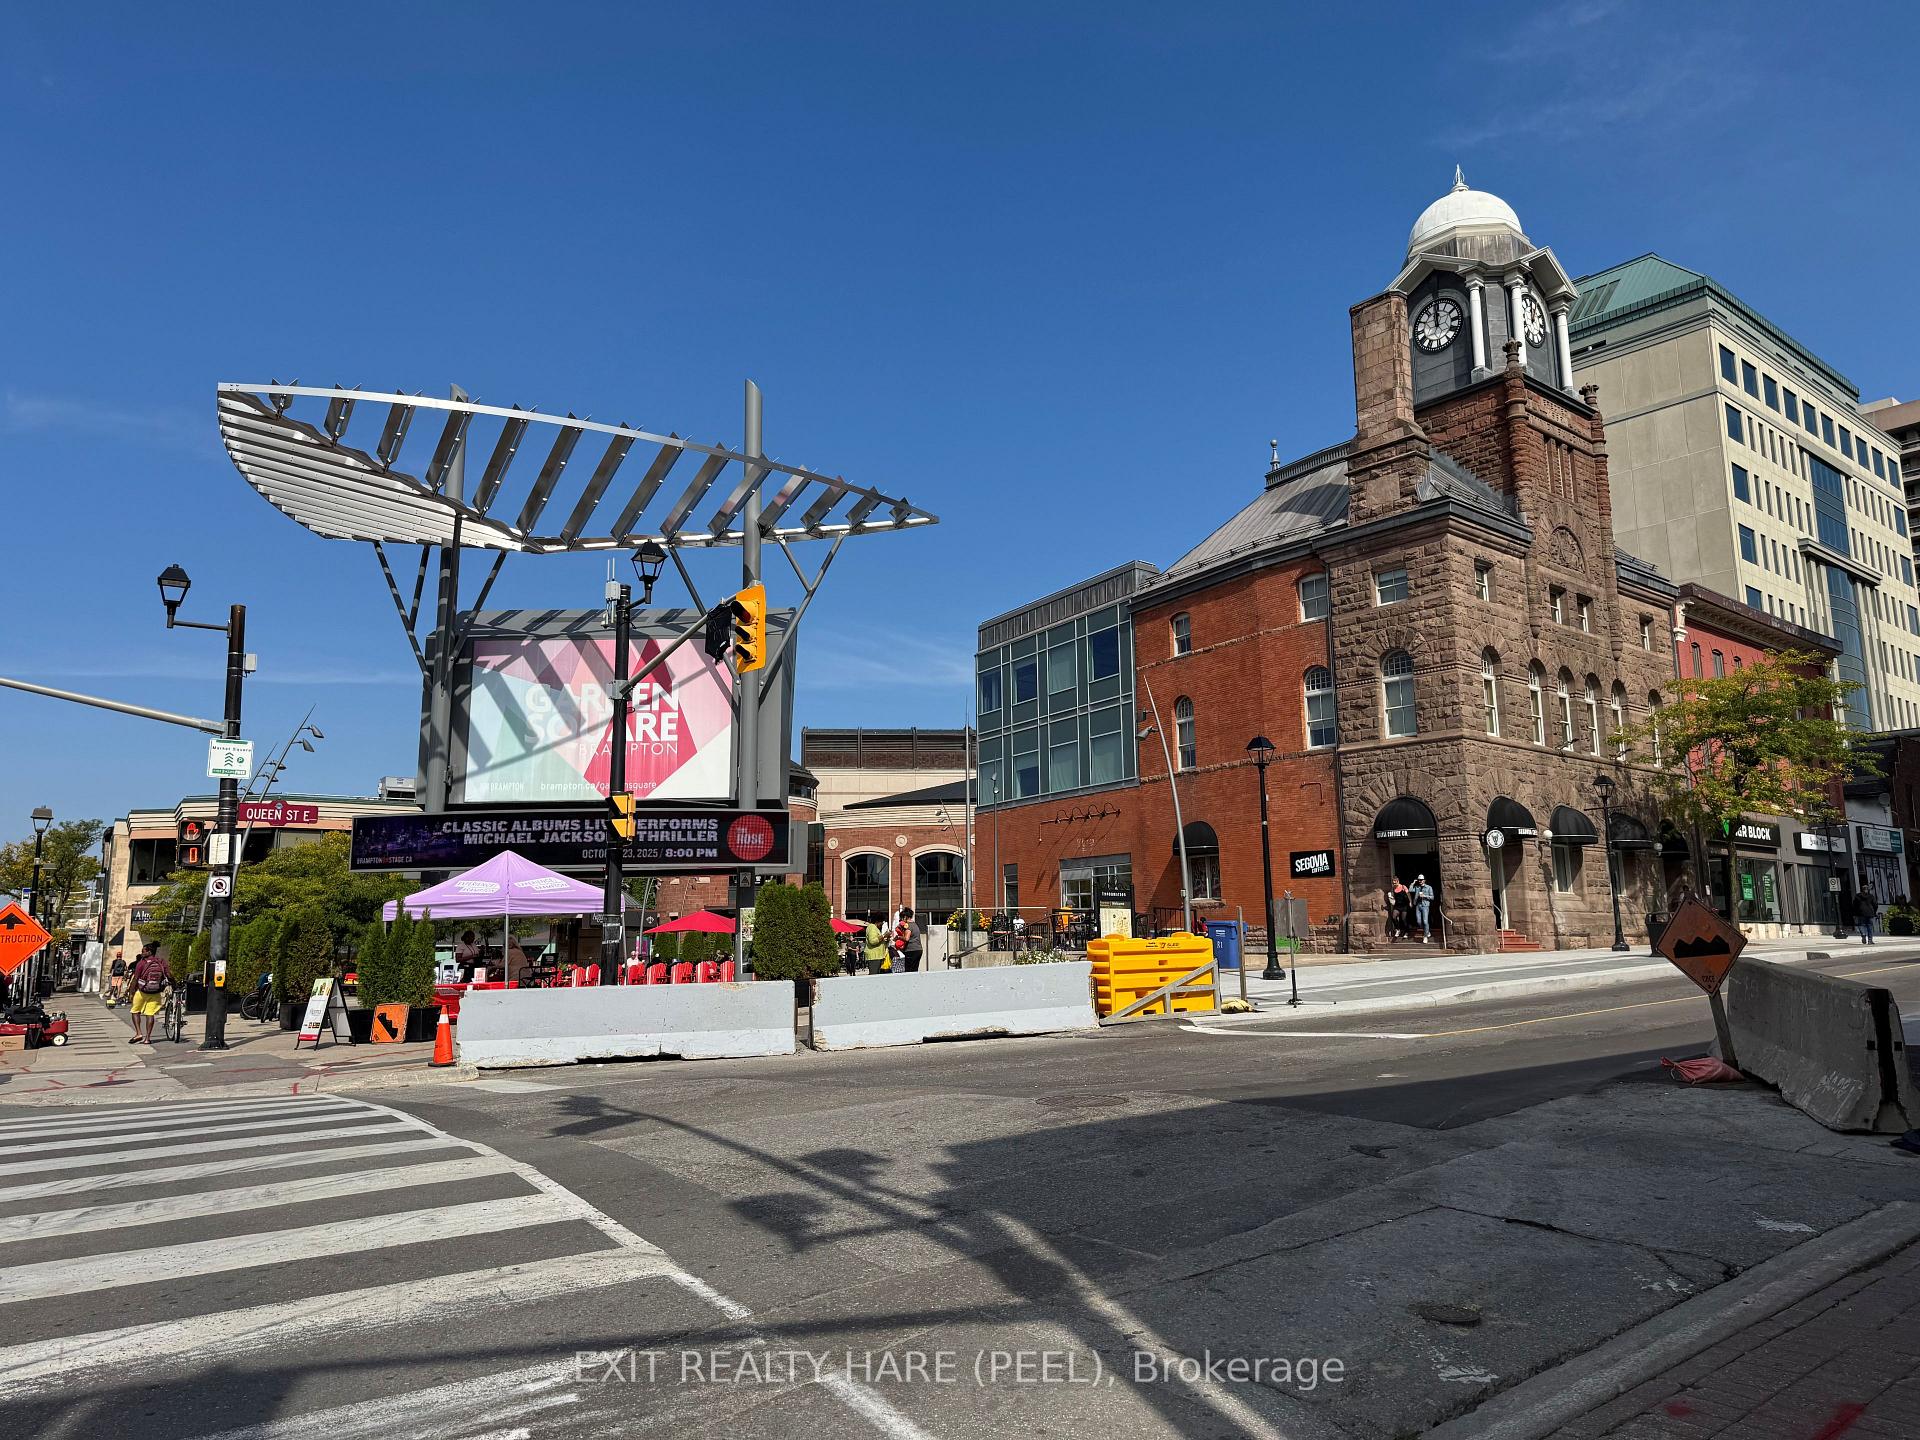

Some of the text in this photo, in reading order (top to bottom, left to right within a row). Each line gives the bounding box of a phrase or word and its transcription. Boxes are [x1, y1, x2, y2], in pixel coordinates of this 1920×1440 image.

[526, 682, 679, 712] GAREN
[579, 742, 678, 755] BRAPTON
[541, 781, 657, 793] brampton.ca/gansquare
[246, 808, 310, 821] QUEEN ST E
[442, 818, 718, 833] CLASSIC ALBUMS LIV ERFORMS
[1748, 825, 1771, 840] BLOCK
[463, 830, 718, 845] MICHAEL JACKSO THRILLER
[582, 848, 606, 859] OCTO
[665, 848, 694, 858] 8:00
[696, 848, 718, 858] PM
[1295, 853, 1328, 872] SEGOVIA
